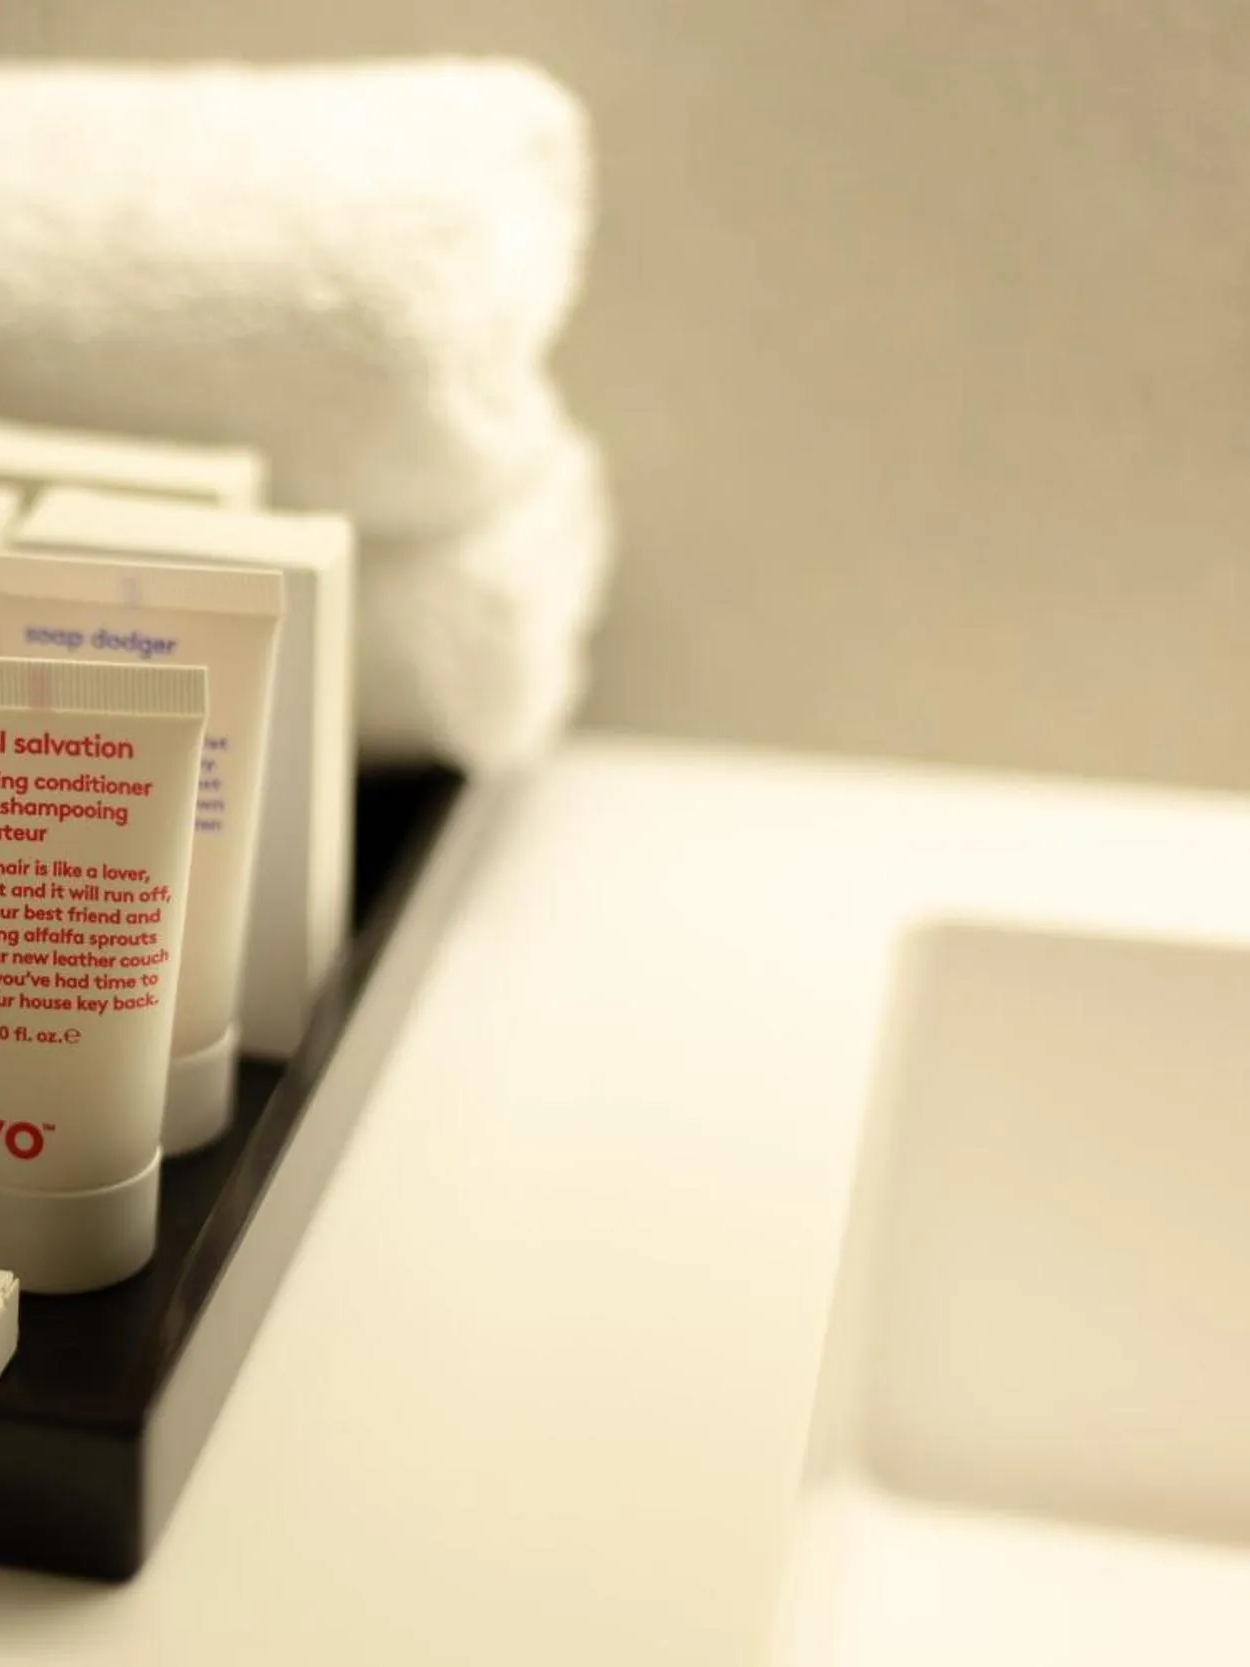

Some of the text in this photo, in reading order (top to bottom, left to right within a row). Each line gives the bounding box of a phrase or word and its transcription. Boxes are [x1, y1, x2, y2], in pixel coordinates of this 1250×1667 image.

[26, 626, 177, 659] soap dodger
[14, 733, 133, 759] salvation
[34, 775, 152, 797] conditioner
[35, 860, 47, 876] is
[53, 861, 81, 877] like
[87, 867, 97, 879] a
[103, 864, 150, 883] lover,
[12, 883, 45, 899] and
[51, 883, 64, 899] it
[69, 885, 99, 901] will
[104, 892, 133, 903] run
[140, 886, 170, 903] off,
[24, 905, 62, 922] best
[68, 908, 120, 924] friend
[126, 909, 160, 924] and
[24, 927, 83, 944] alfalfa
[90, 932, 157, 949] sprouts
[13, 951, 49, 965] new
[53, 951, 115, 967] leather
[120, 950, 168, 966] couch
[55, 974, 89, 989] had
[94, 974, 136, 989] time
[142, 974, 158, 986] to
[19, 993, 71, 1010] house
[77, 995, 108, 1016] key
[114, 993, 159, 1011] back.
[14, 1026, 32, 1041] fl.
